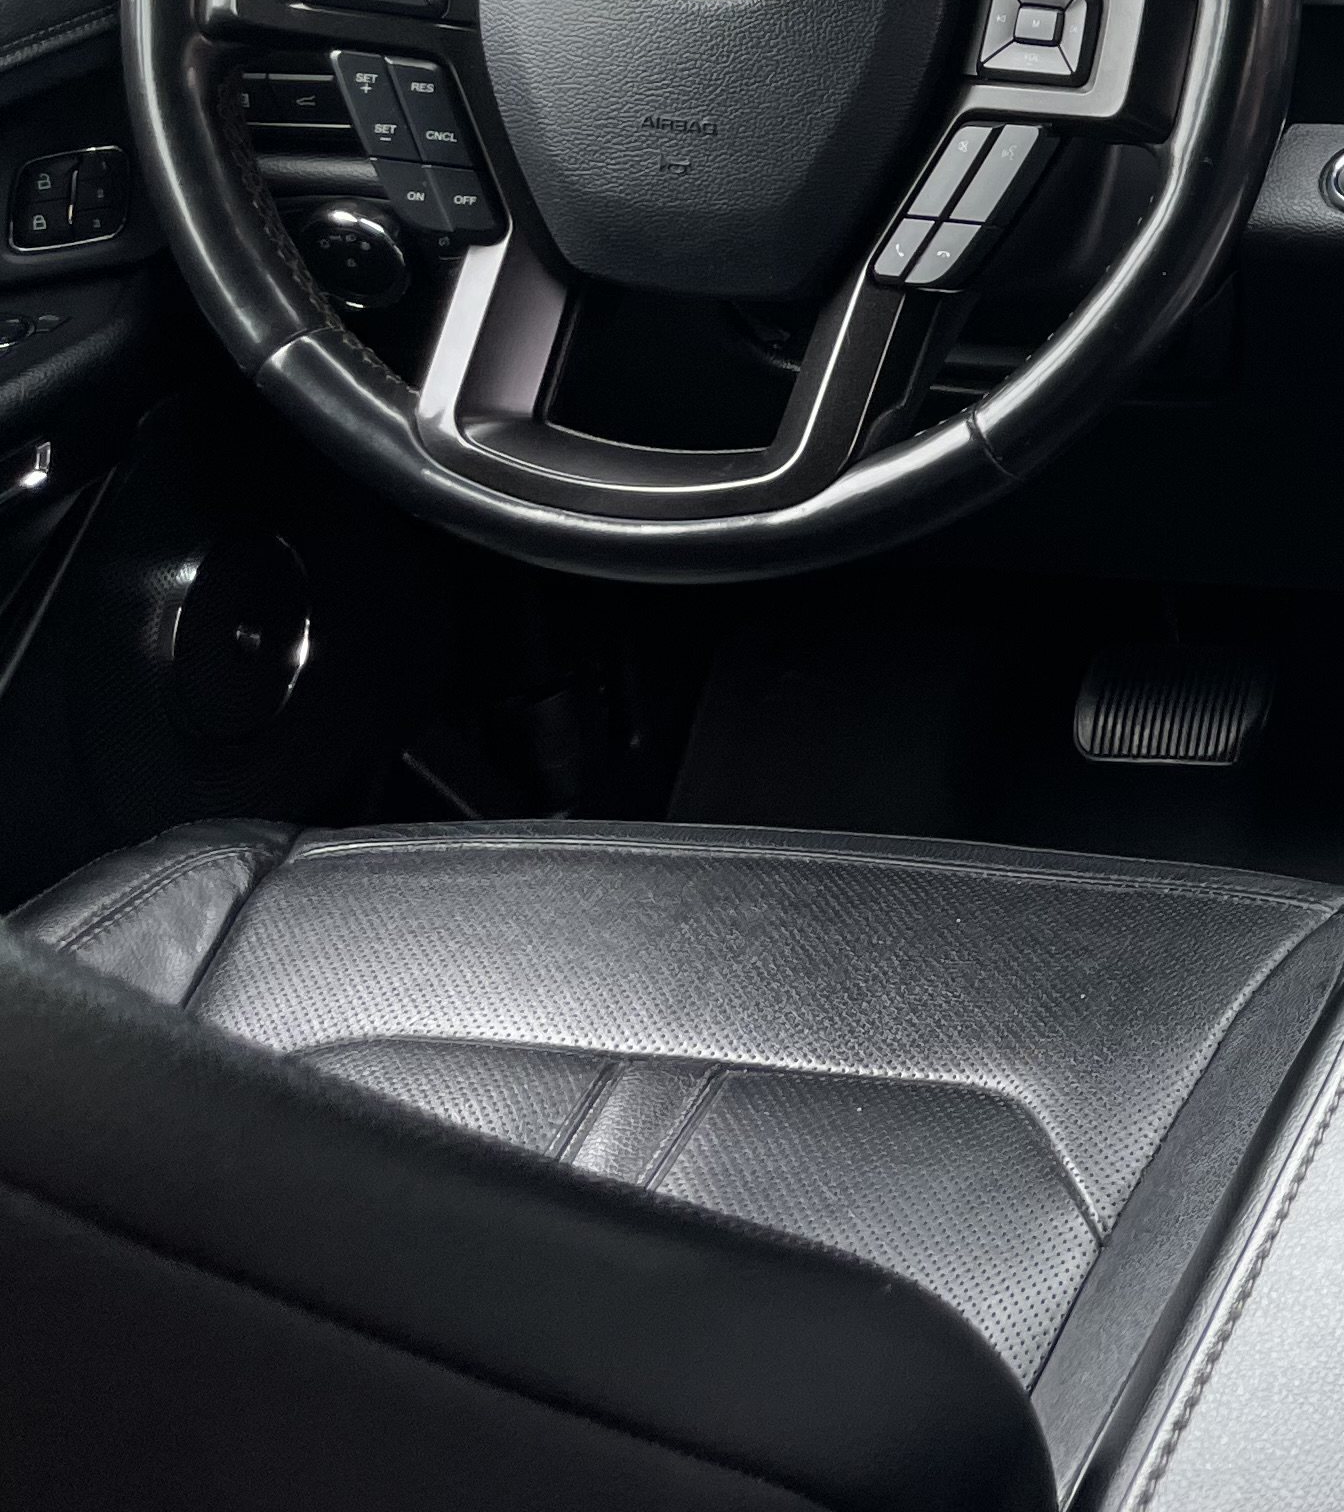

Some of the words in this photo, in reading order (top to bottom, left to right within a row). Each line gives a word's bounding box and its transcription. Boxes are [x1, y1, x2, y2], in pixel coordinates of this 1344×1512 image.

[356, 72, 378, 84] SET
[410, 82, 435, 94] RES
[374, 123, 397, 135] SET
[641, 116, 718, 137] AIRBAG
[426, 130, 457, 144] CNCL
[407, 191, 425, 202] ON
[453, 194, 477, 207] OFF
